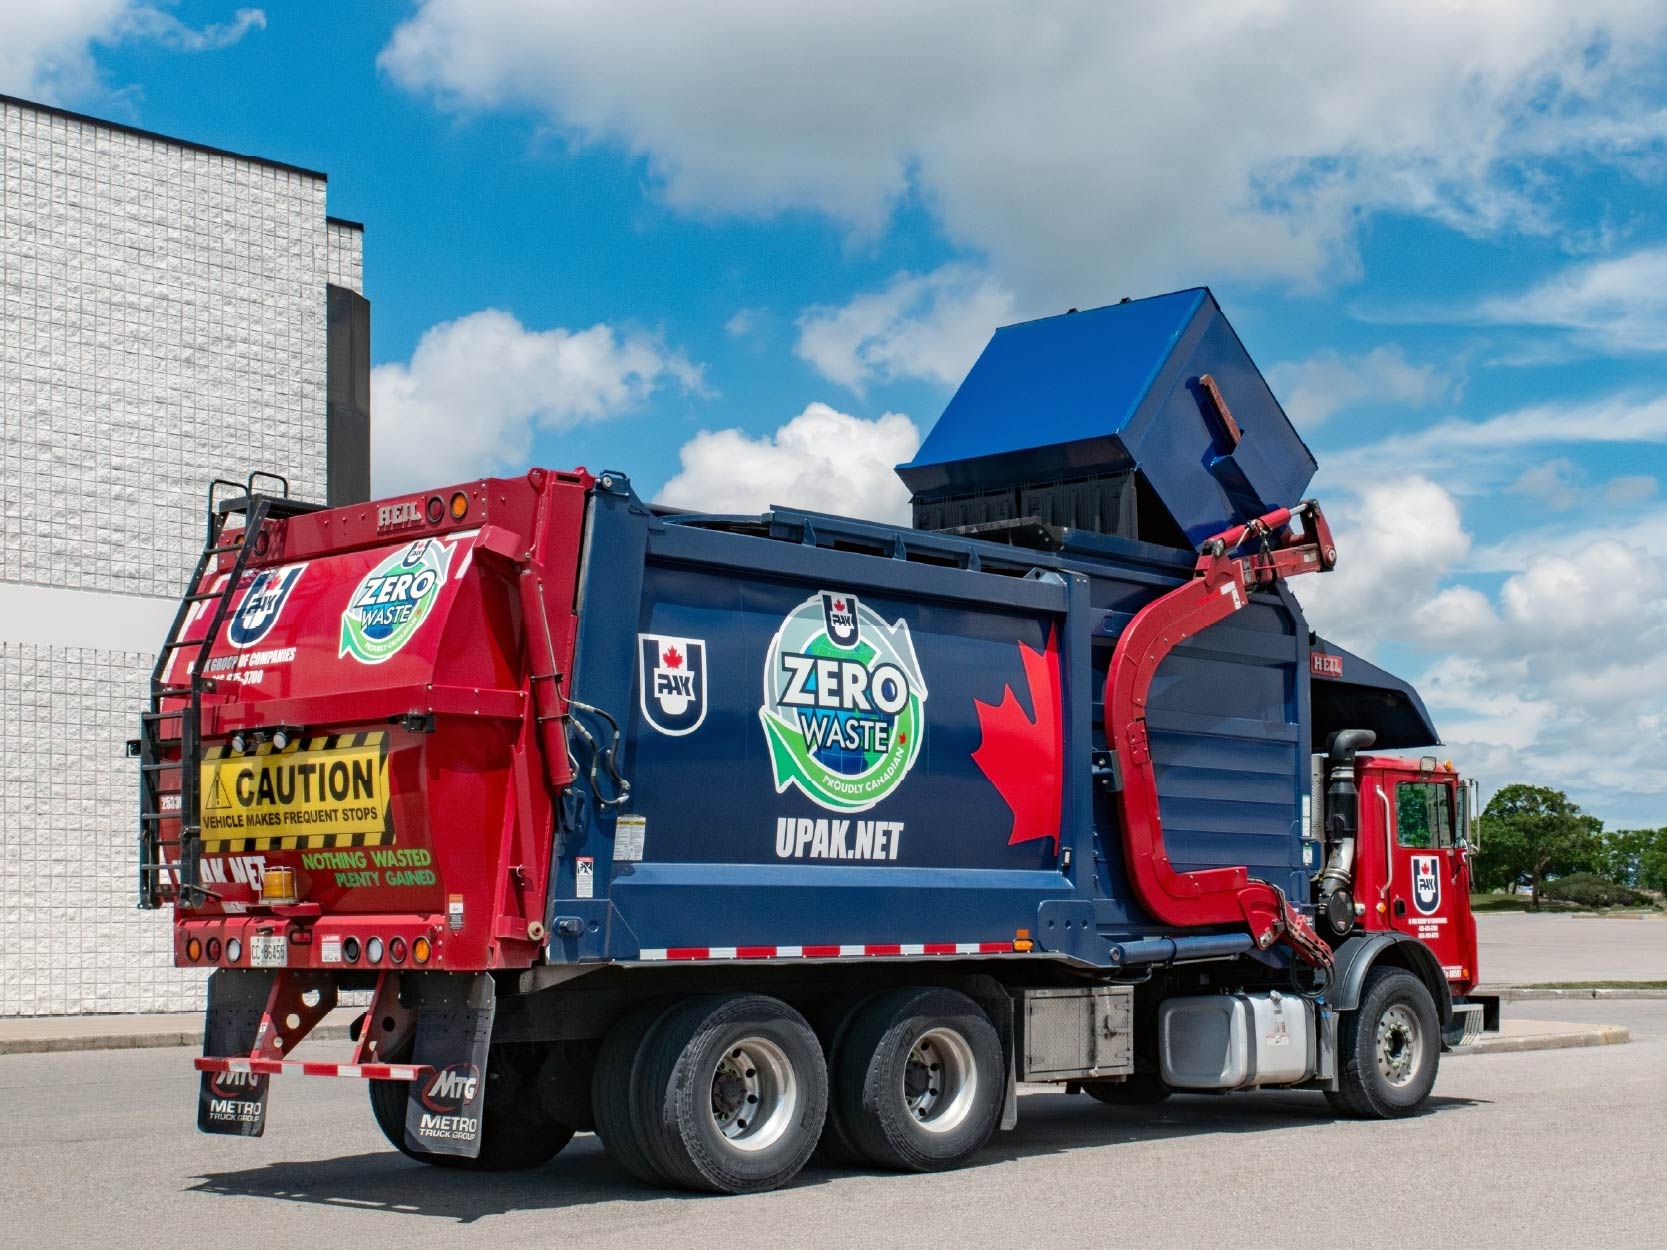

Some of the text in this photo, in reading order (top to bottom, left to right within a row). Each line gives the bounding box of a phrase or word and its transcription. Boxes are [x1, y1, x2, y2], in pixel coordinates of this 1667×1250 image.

[379, 502, 421, 526] HEIL
[356, 571, 435, 607] ZERO
[362, 605, 412, 626] WASTE
[238, 653, 251, 667] OF
[249, 647, 297, 666] COMPANIES
[1314, 656, 1341, 673] HEIL
[780, 654, 909, 715] ZERO
[801, 714, 888, 751] WASTE
[823, 748, 905, 794] PROUDLY CANADIAN
[236, 759, 374, 807] CAUTION
[203, 807, 378, 829] VEHICLE MAKES FREQUENT STOPS
[776, 817, 905, 860] UPAK.NET
[301, 848, 432, 870] NOTHING WASTED
[334, 869, 436, 887] PLENTY GAINED
[427, 1070, 477, 1099] MTG
[209, 1112, 260, 1122] TRUCK GROUP
[210, 1099, 262, 1116] METRO
[420, 1114, 477, 1132] METRO
[419, 1128, 476, 1141] TRUCK GROUP
